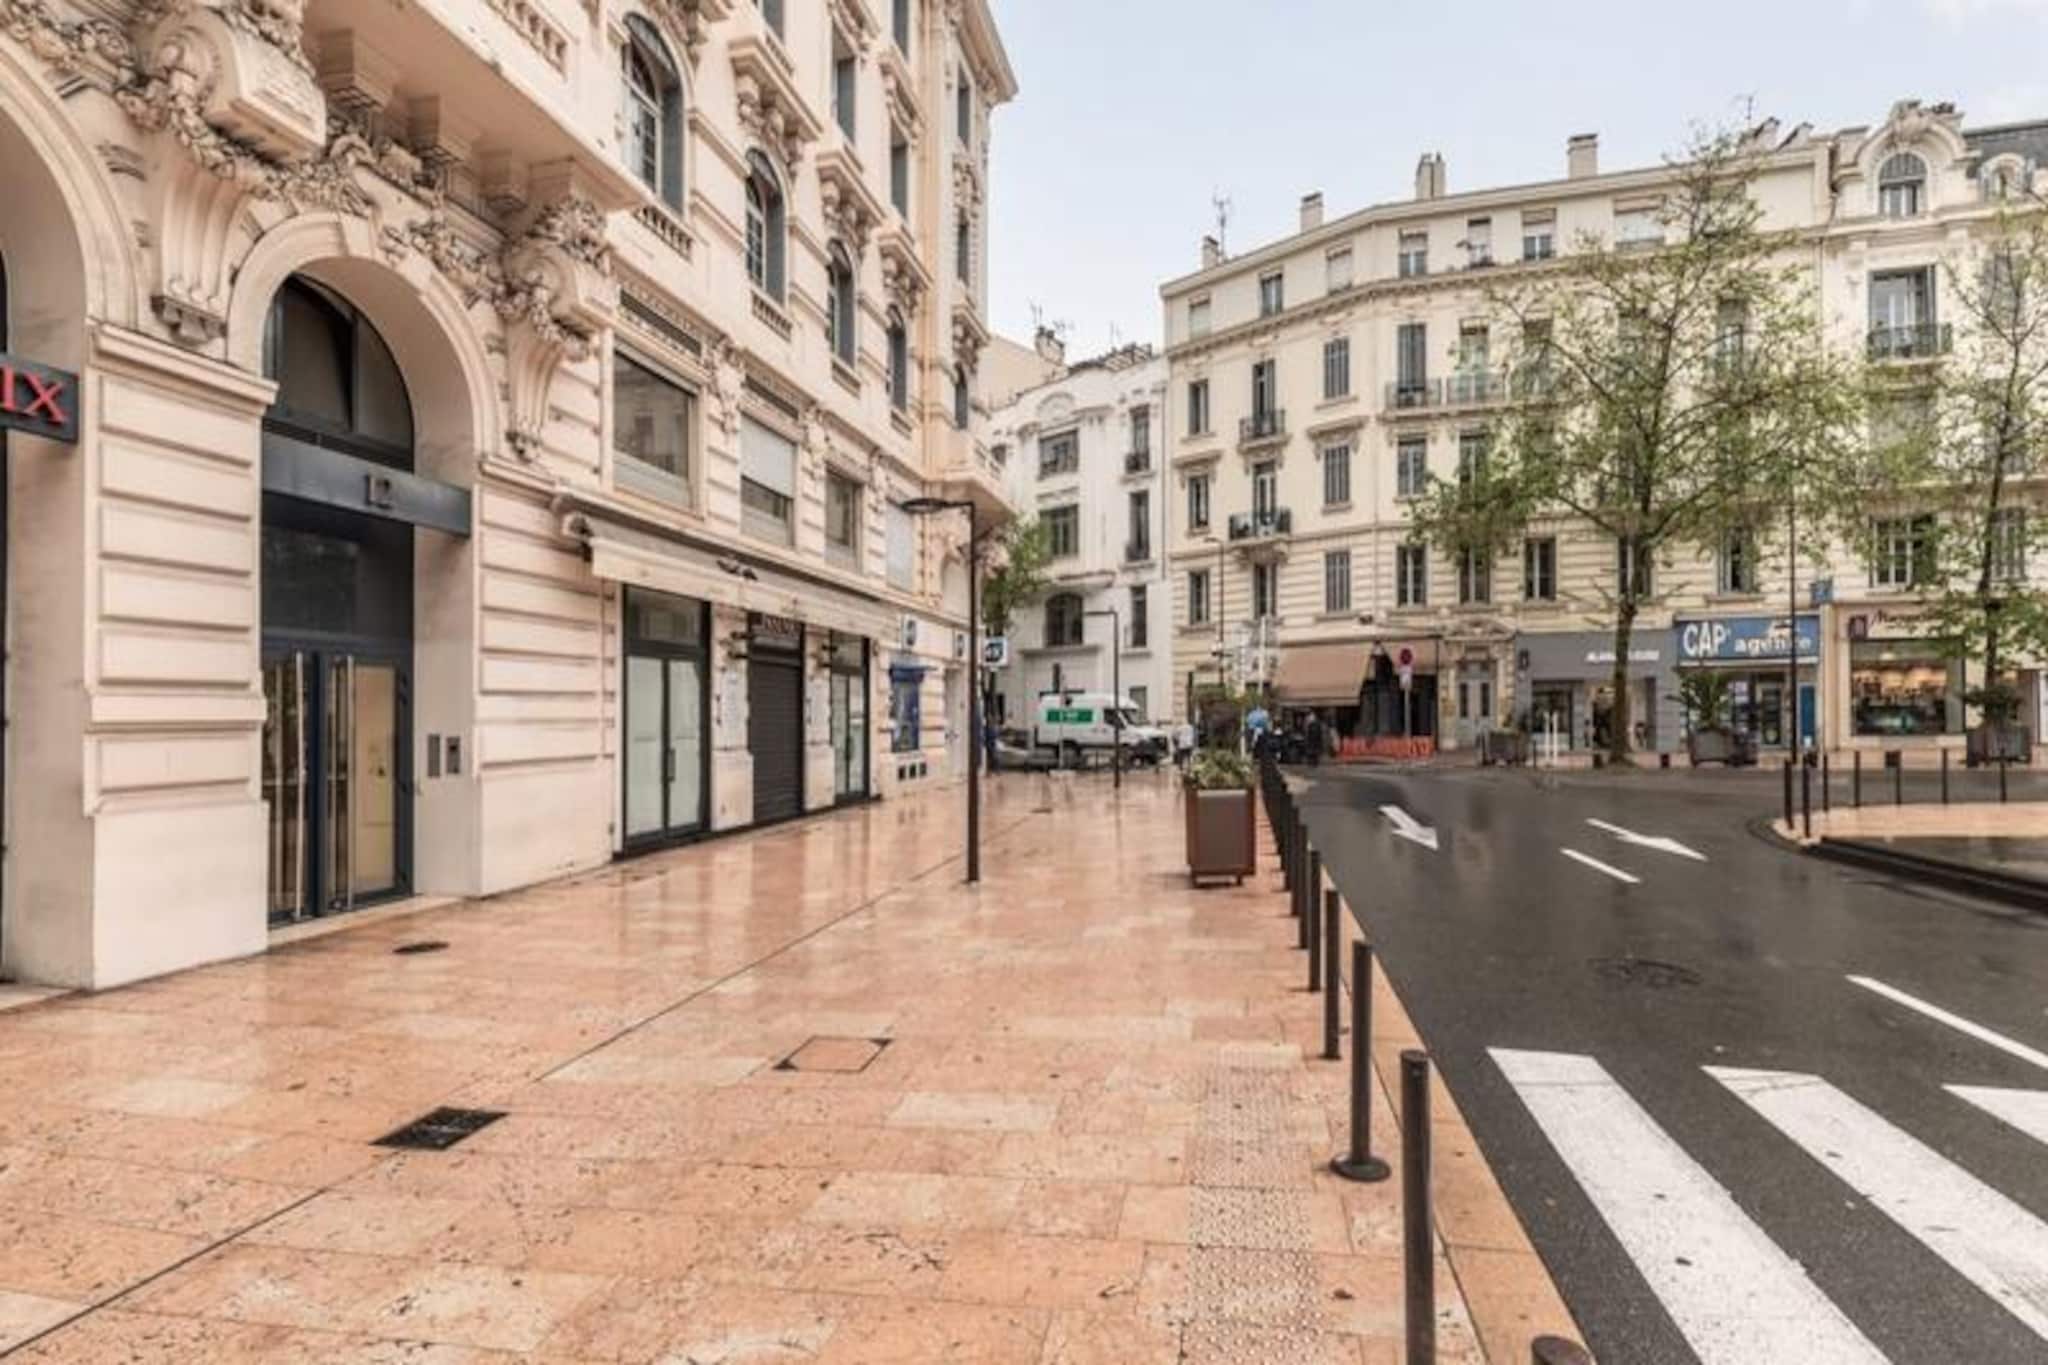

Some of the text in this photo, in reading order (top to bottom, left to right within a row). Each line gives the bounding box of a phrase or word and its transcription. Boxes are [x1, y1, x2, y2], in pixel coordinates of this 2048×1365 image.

[363, 474, 394, 511] 12
[1683, 622, 1727, 657] CAP
[1734, 637, 1812, 657] agene
